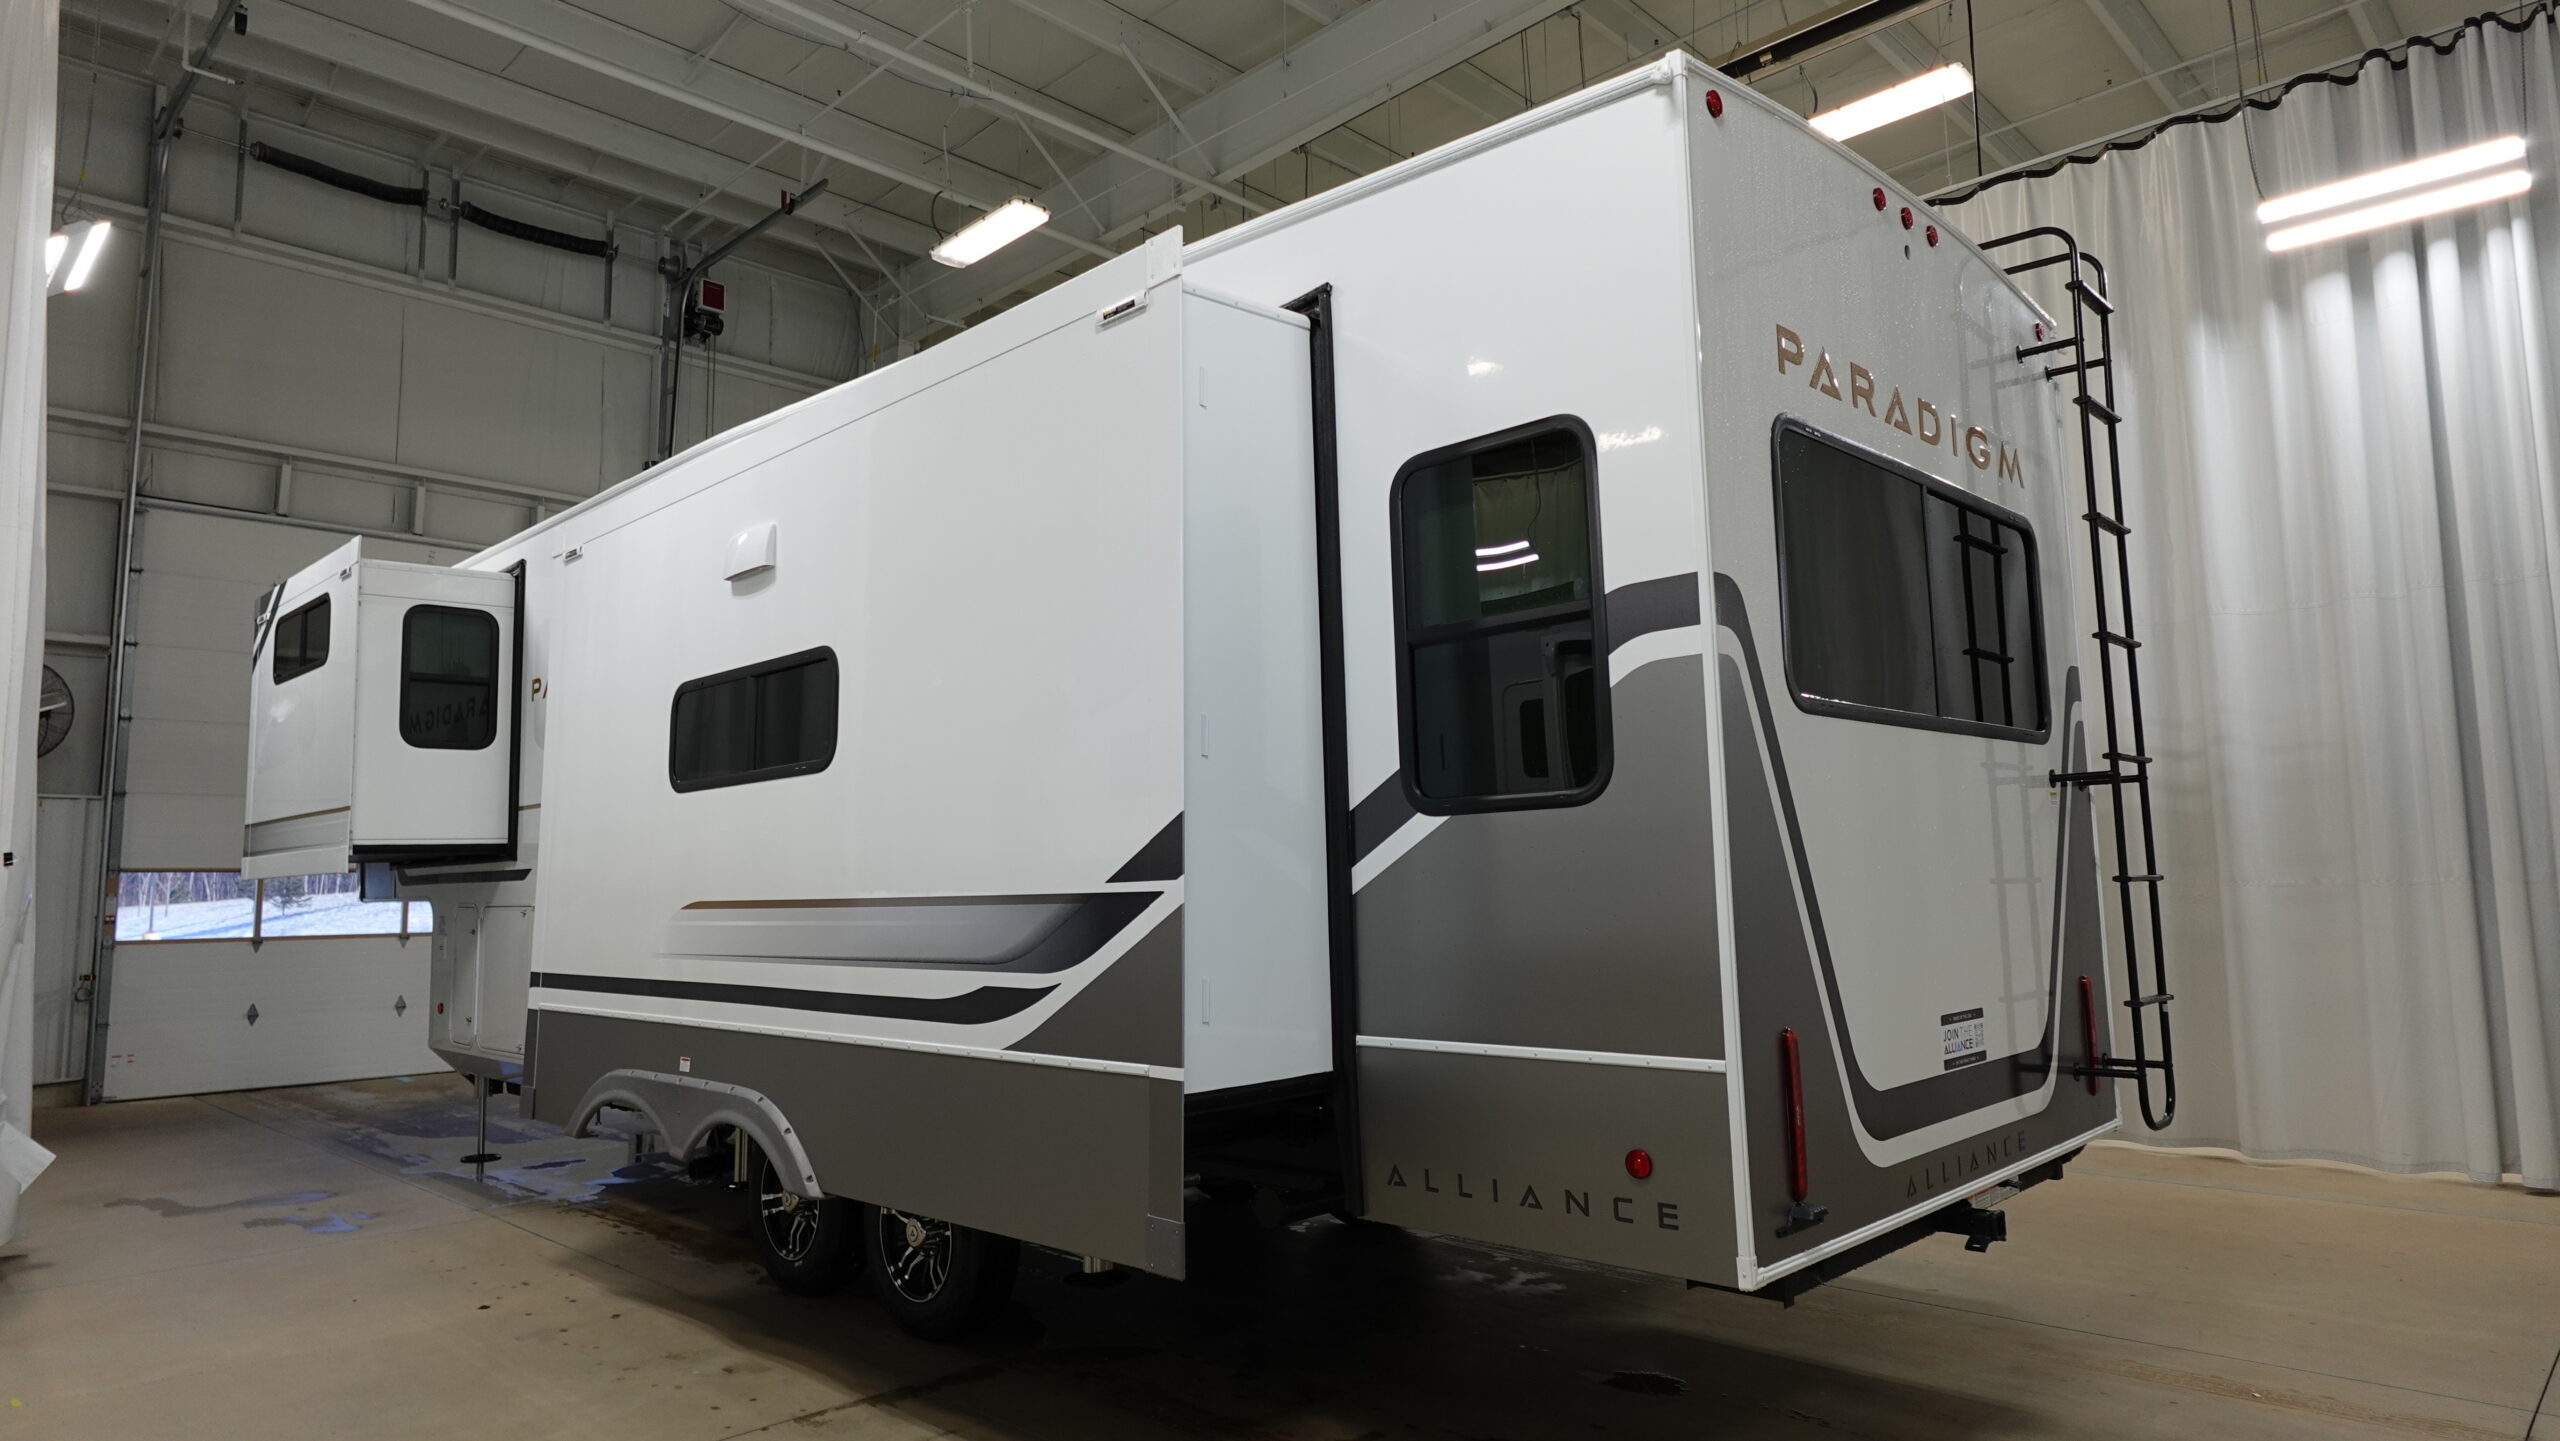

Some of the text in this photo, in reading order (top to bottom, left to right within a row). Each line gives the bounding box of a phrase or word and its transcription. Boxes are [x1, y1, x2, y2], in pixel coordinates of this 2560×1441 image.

[1775, 323, 2025, 489] PARADIGM
[1943, 1024, 1972, 1042] JOIN THE
[1944, 1038, 1974, 1055] ALLIANCE
[1386, 1164, 1680, 1231] ALLIANCE
[1906, 1130, 2027, 1199] ALLIANCE
